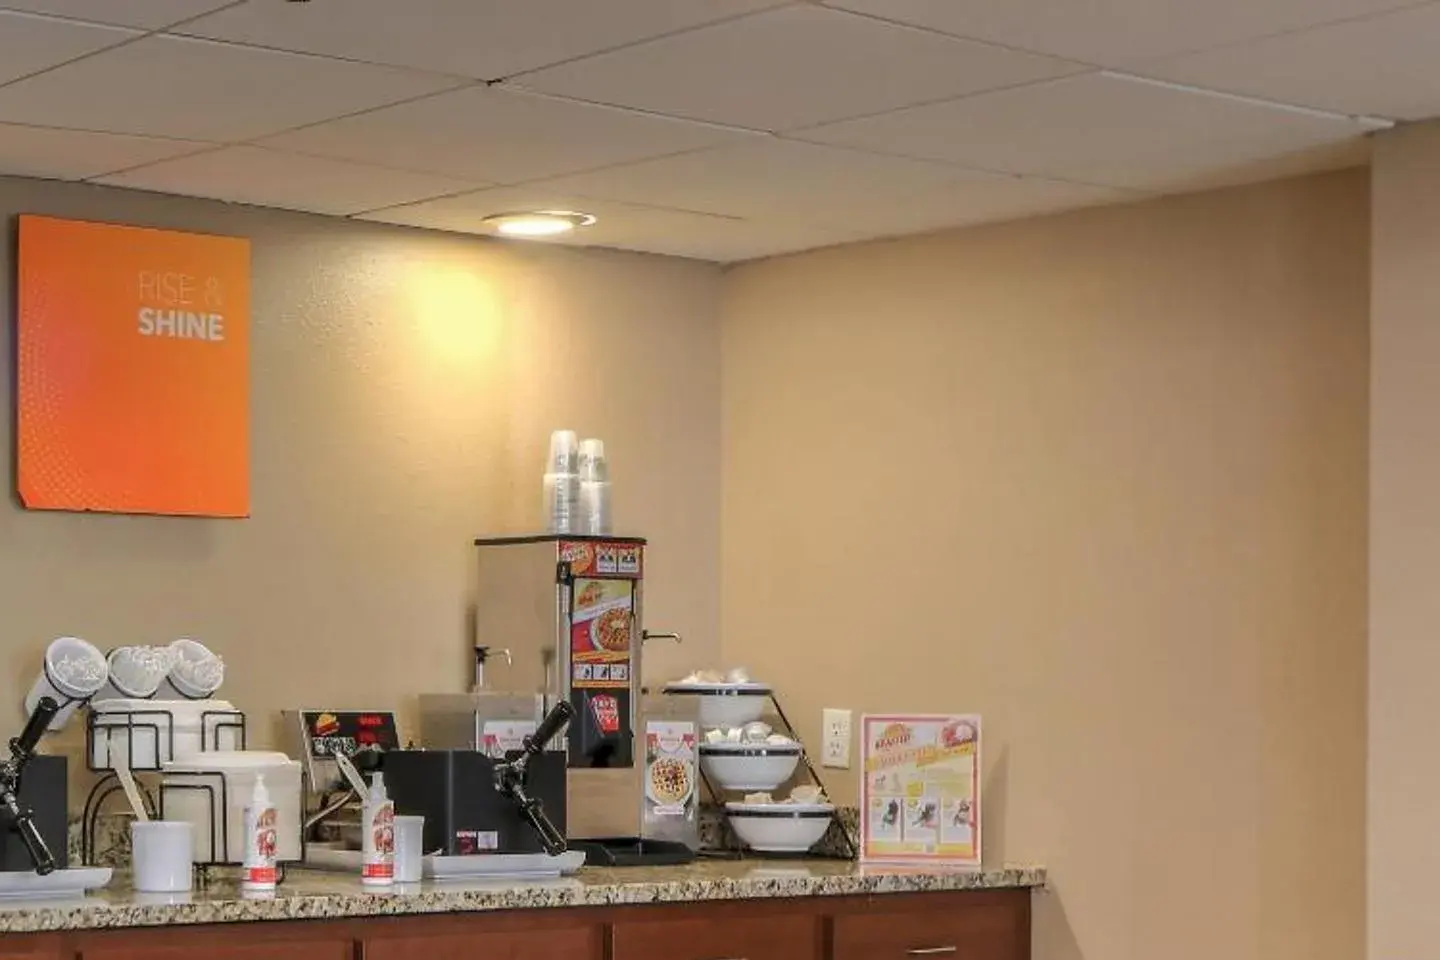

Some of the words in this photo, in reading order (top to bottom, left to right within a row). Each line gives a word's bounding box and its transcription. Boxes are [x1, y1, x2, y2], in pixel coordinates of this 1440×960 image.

[138, 272, 195, 304] RISE
[203, 276, 222, 305] &
[138, 307, 224, 341] SHINE
